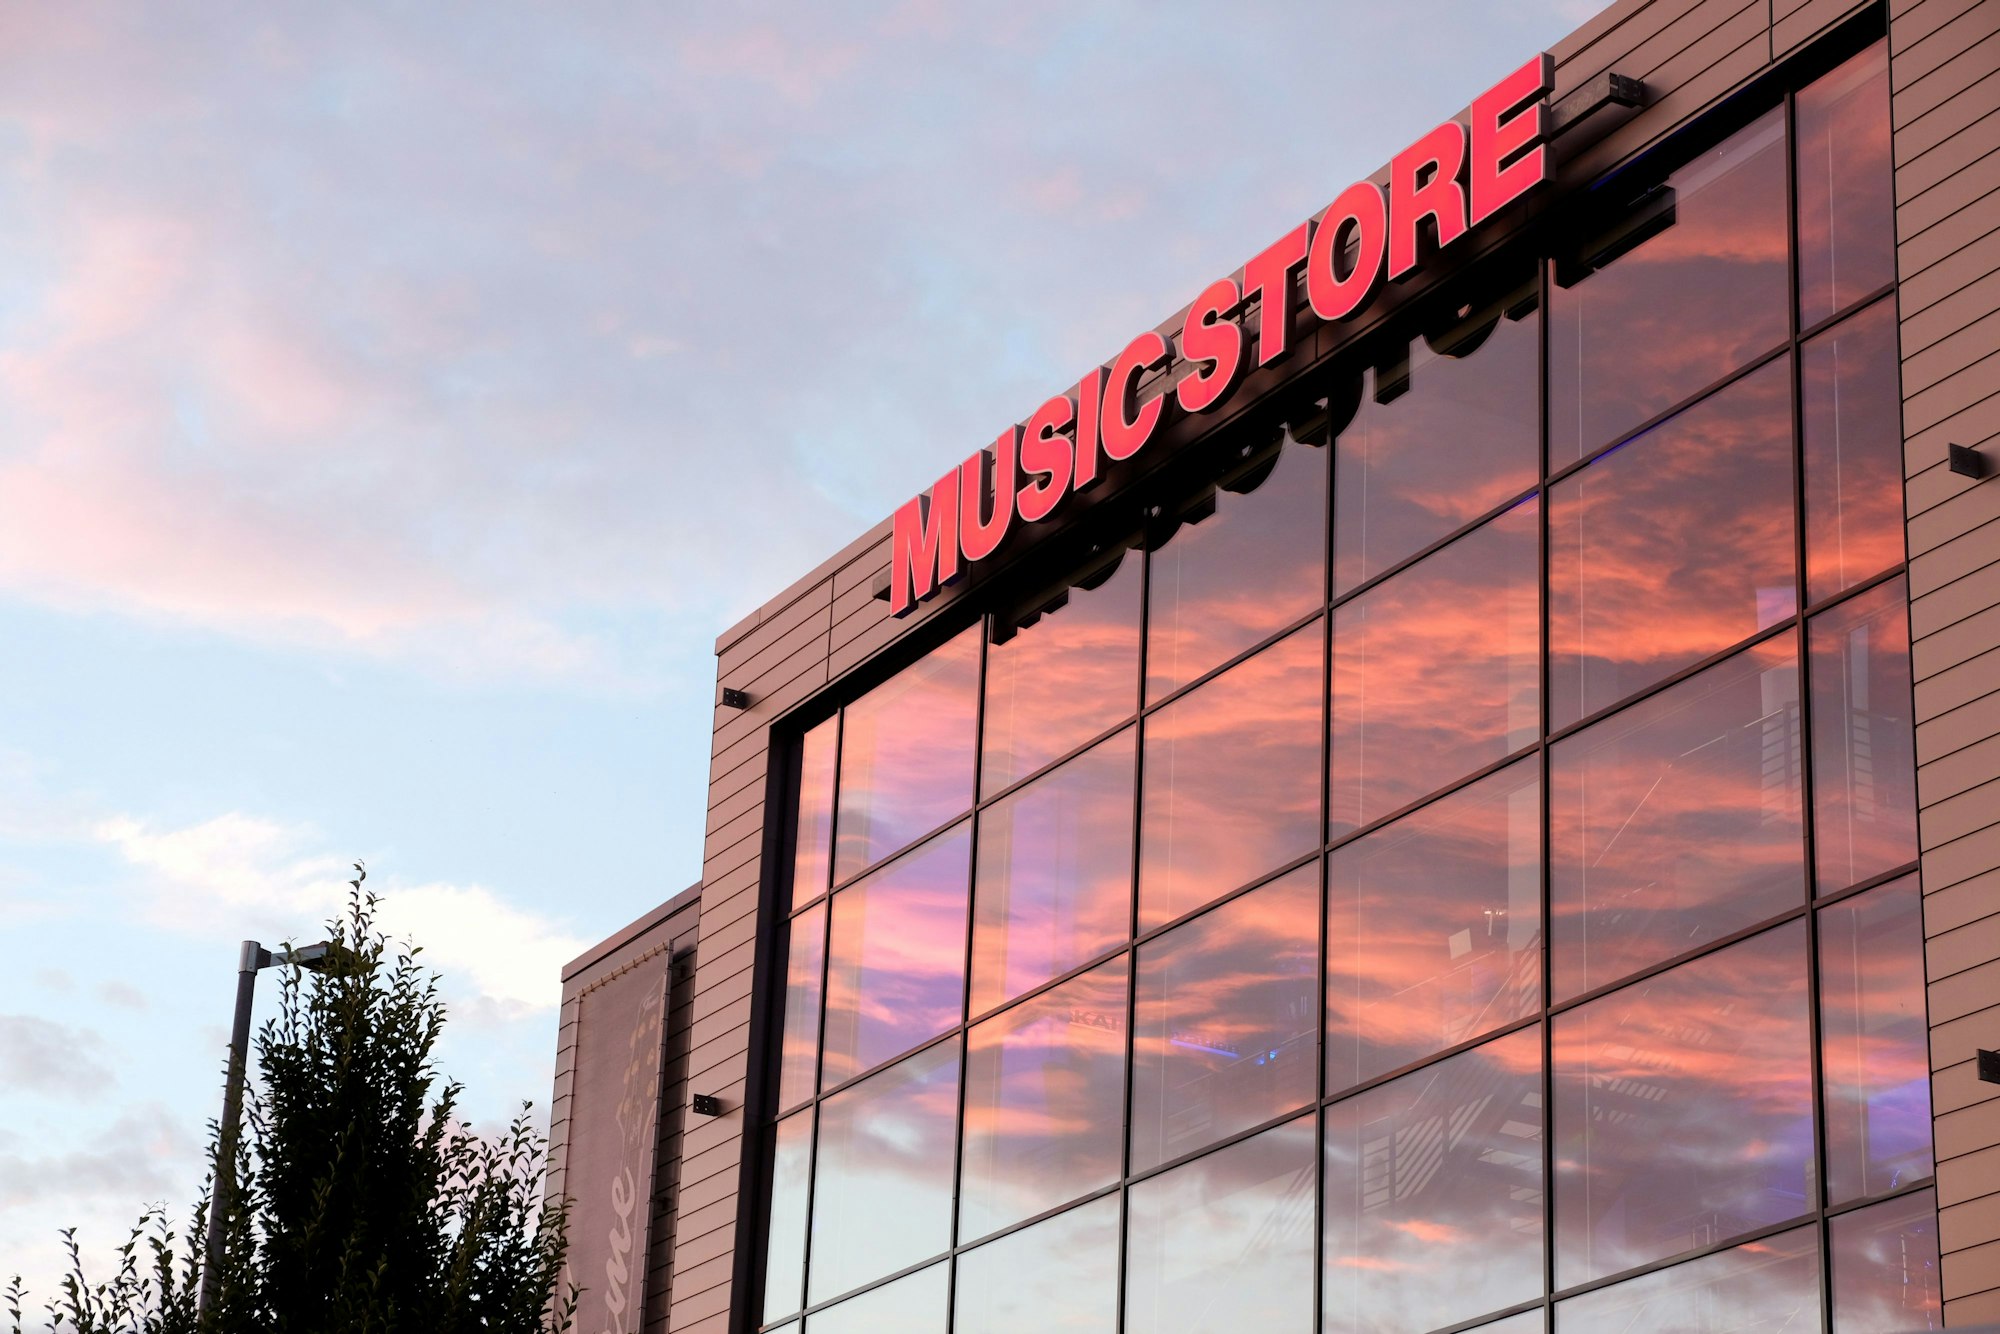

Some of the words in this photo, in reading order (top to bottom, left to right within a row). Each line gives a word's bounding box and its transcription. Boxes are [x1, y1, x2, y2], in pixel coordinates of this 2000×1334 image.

[890, 331, 1171, 618] MUSIC
[1177, 51, 1552, 414] STORE
[603, 1166, 636, 1334] me
